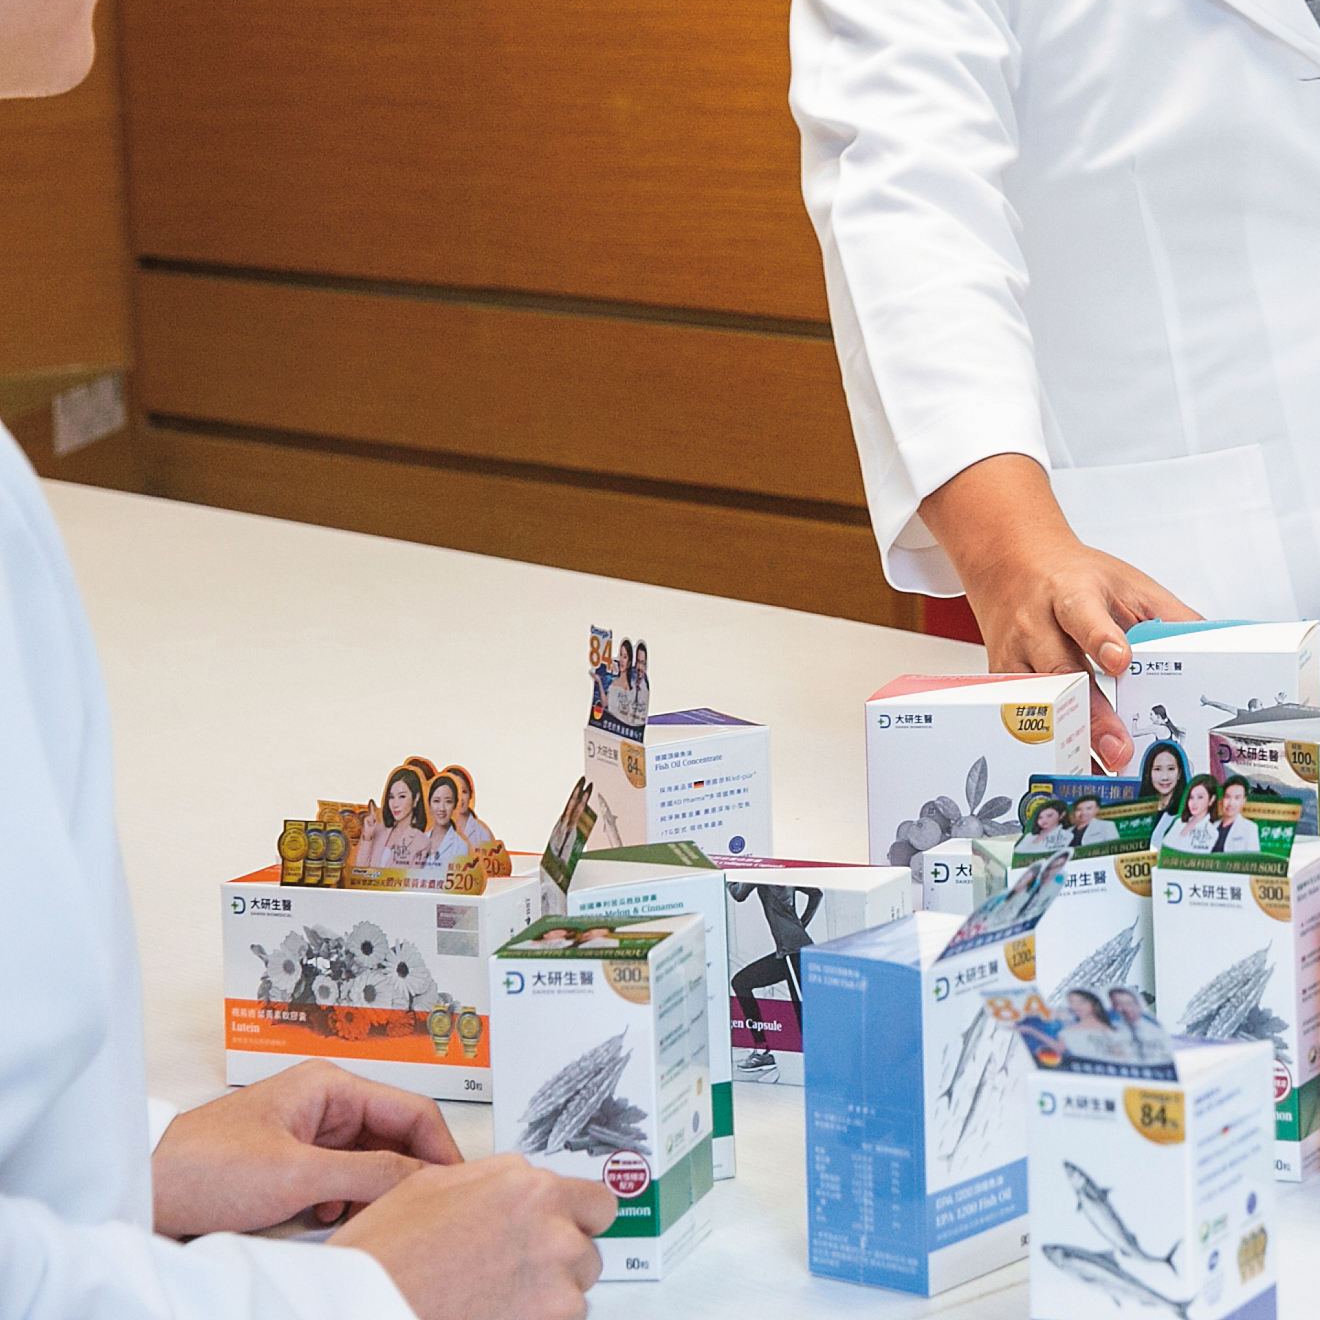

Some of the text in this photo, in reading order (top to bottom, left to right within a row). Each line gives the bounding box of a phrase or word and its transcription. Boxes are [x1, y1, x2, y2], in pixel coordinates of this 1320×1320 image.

[1016, 706, 1049, 717] 甘露糖
[895, 714, 933, 724] 大研生醫
[1236, 746, 1279, 763] 大研生醫
[655, 755, 722, 771] Fish Oil Concentrate
[1059, 785, 1135, 799] 專科醫生推薦
[1064, 870, 1107, 888] 研生醫
[1189, 884, 1242, 900] 大研生醫
[250, 898, 292, 912] 大研生醫
[641, 902, 684, 912] Cinnamon
[532, 970, 594, 986] 大研生醫
[955, 960, 998, 987] 大研生醫
[232, 1021, 259, 1033] Lutein
[746, 1018, 782, 1032] Capsule
